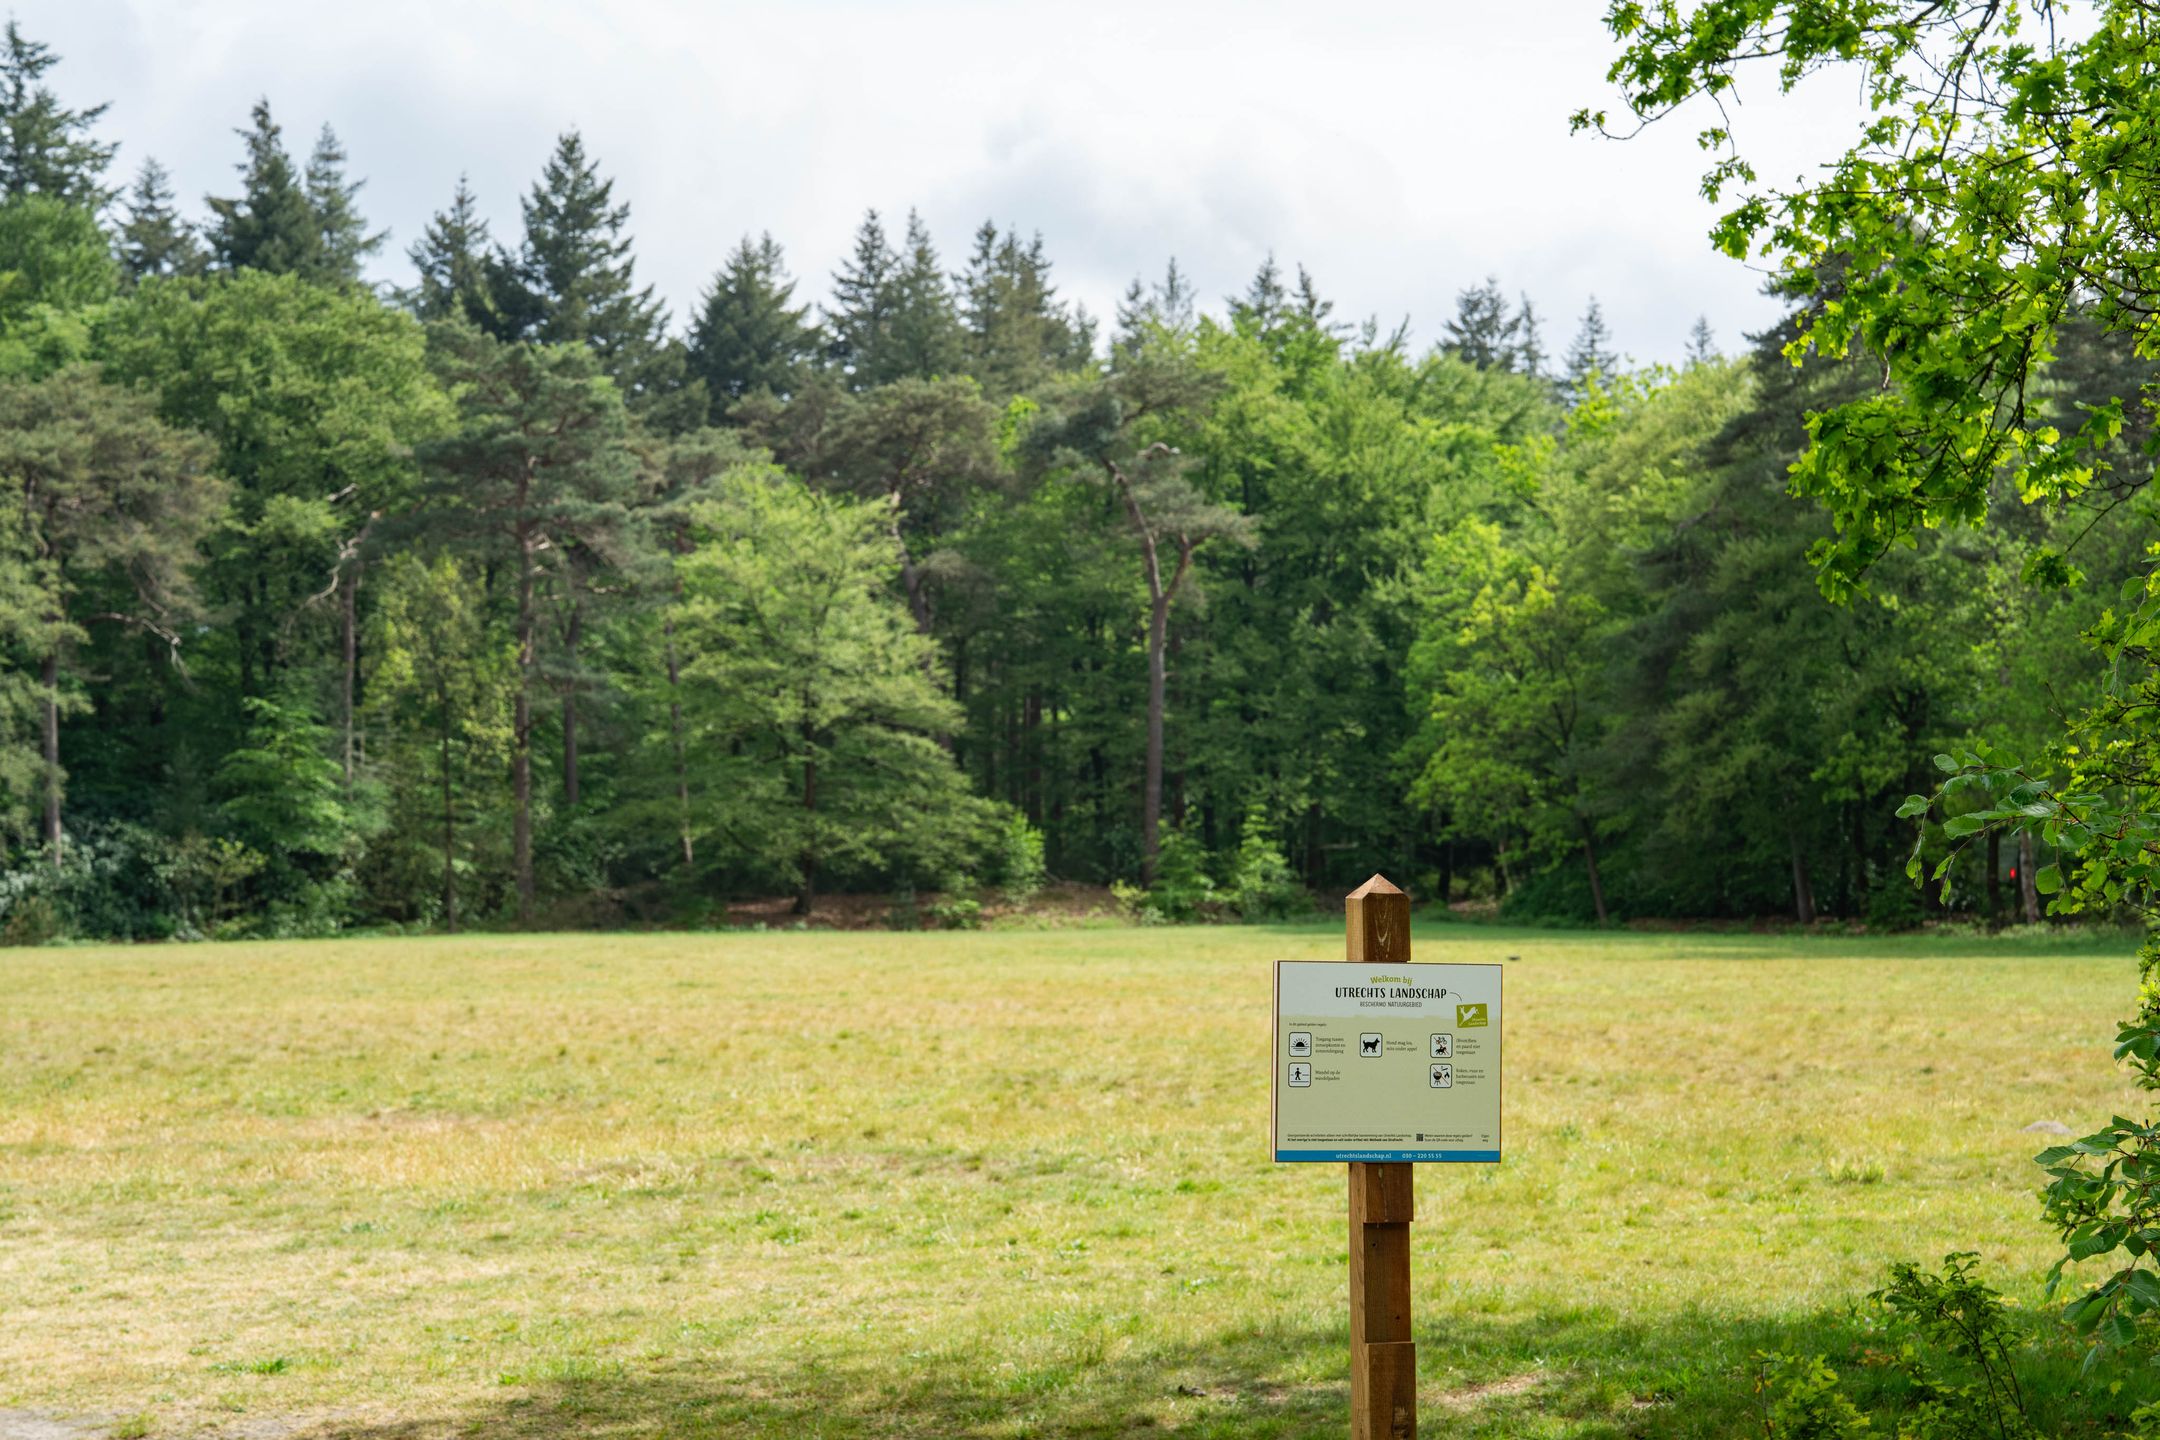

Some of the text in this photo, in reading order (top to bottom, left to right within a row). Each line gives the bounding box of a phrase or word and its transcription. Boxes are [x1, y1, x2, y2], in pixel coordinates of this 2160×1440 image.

[1370, 975, 1413, 986] Welkom bij
[1335, 987, 1447, 999] UTRECHTS LANDSCHAP
